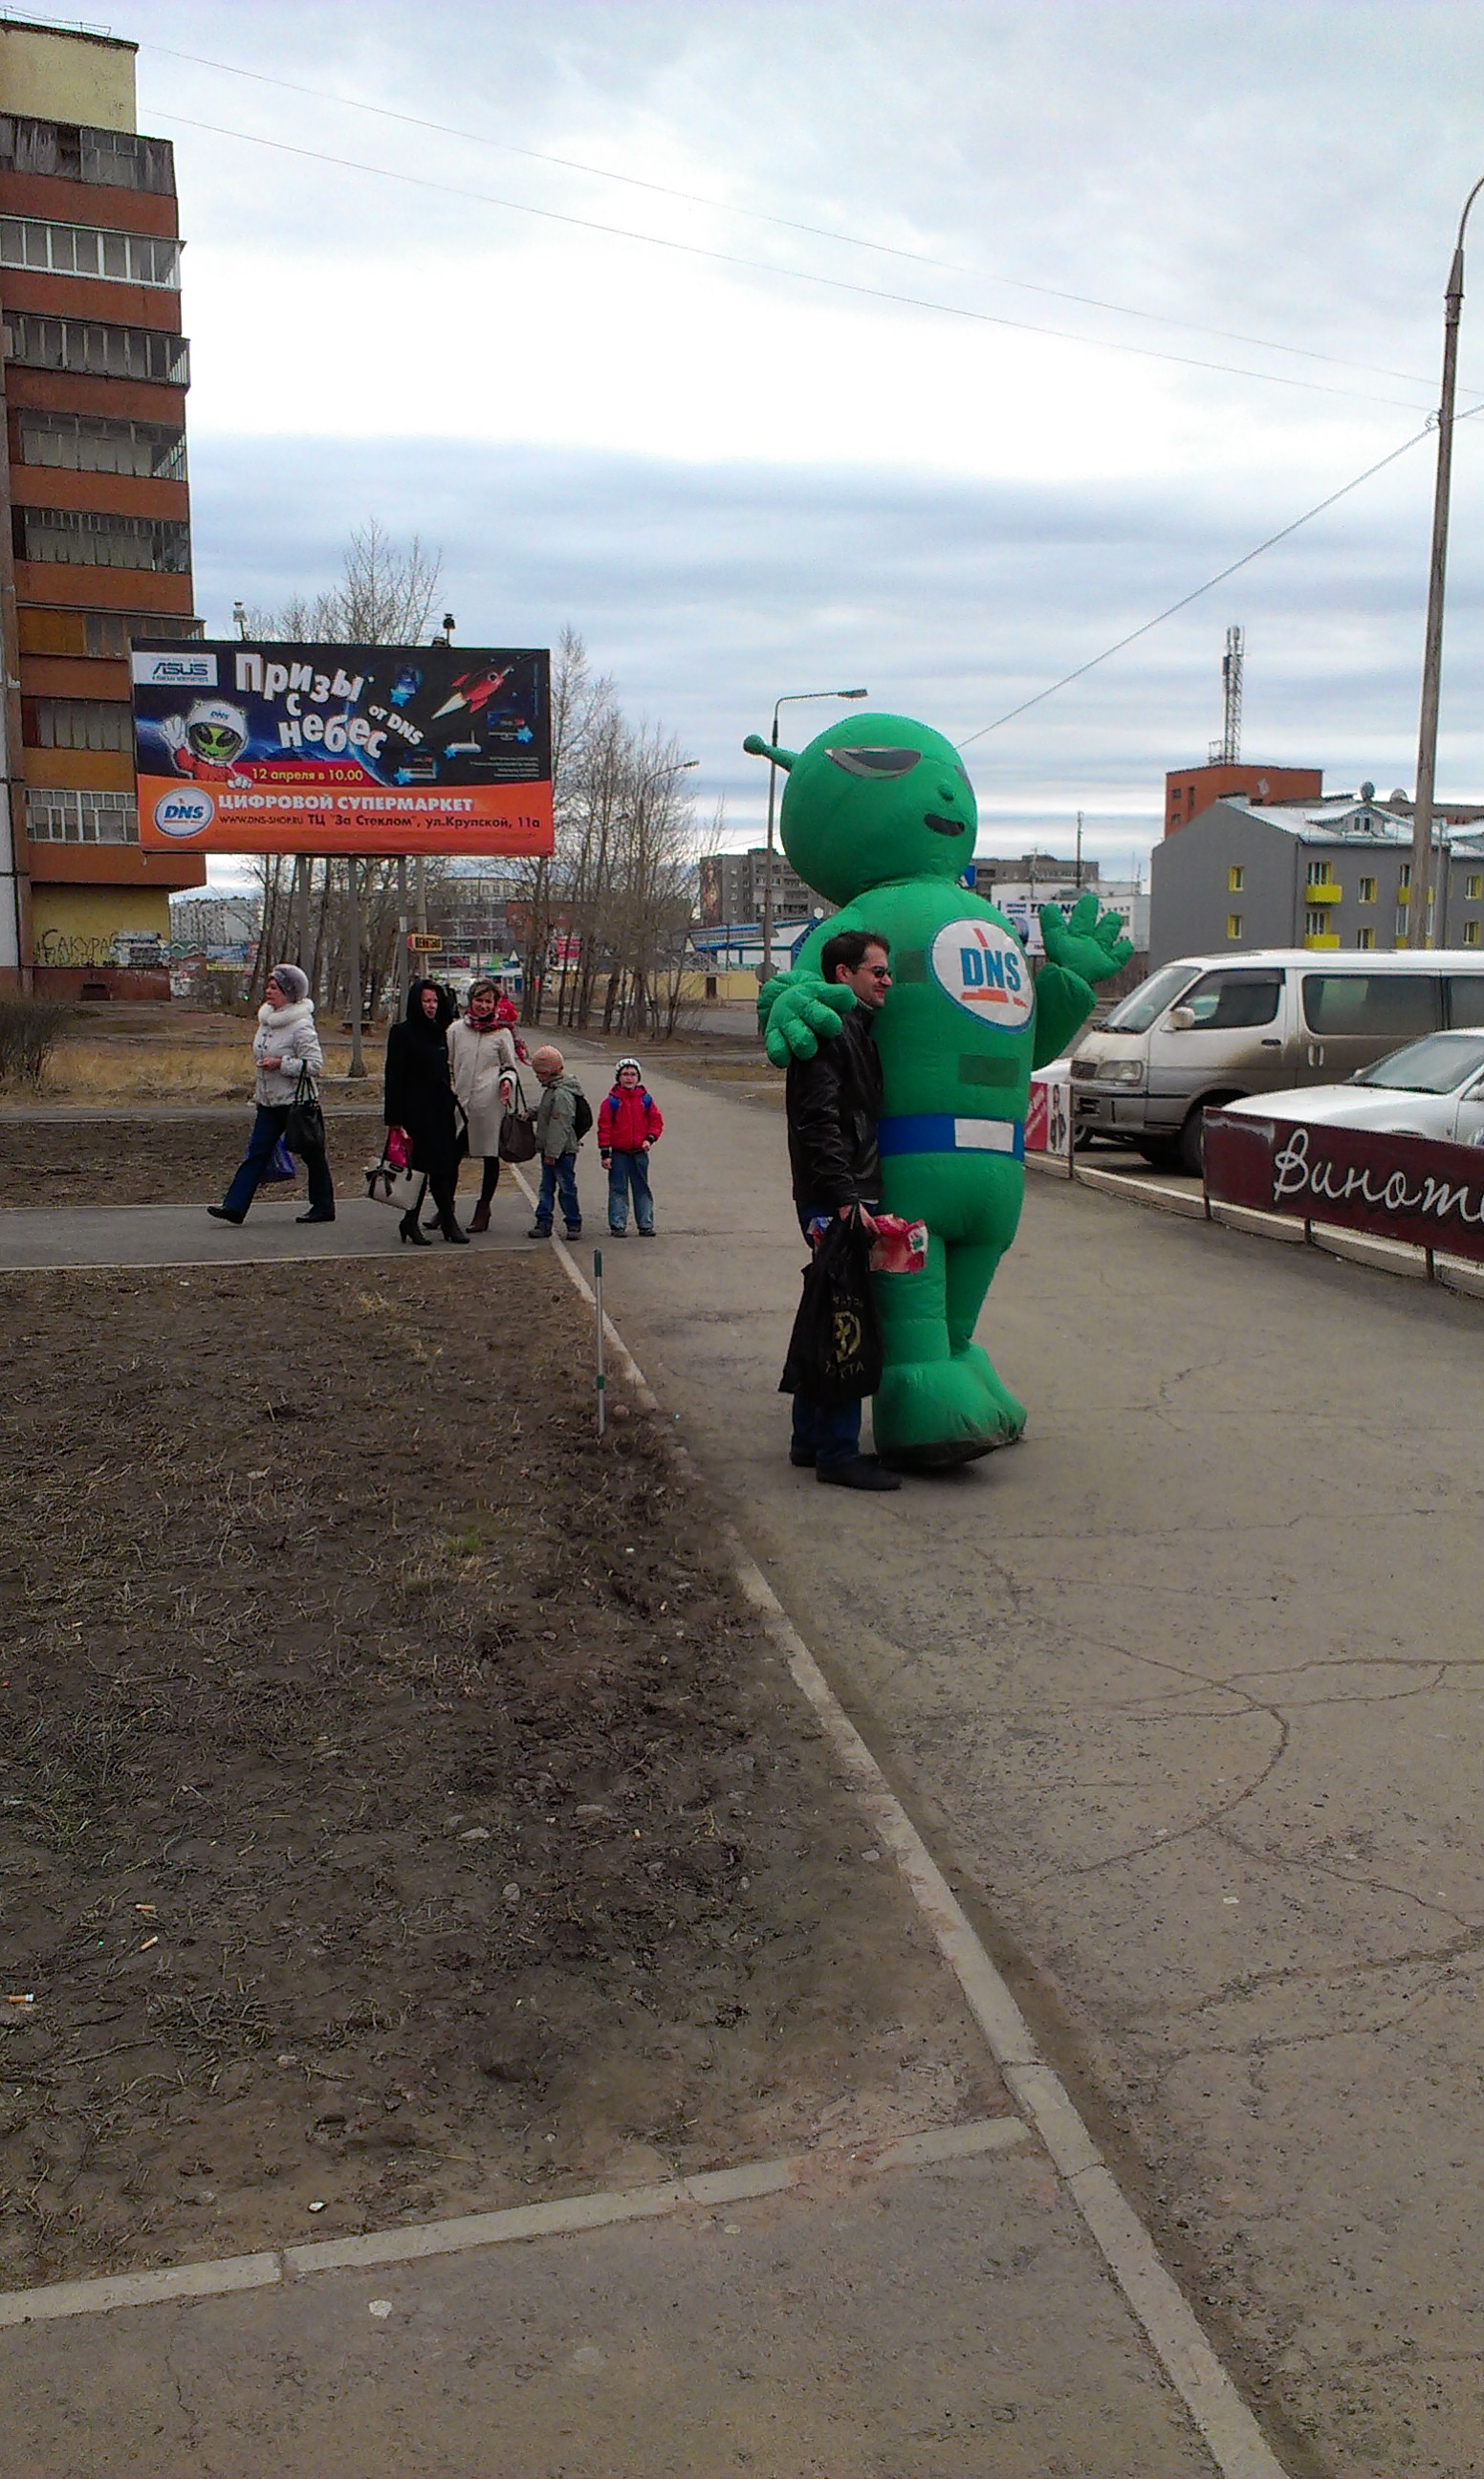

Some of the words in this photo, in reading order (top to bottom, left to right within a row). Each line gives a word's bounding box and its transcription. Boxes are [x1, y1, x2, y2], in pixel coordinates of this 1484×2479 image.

[152, 662, 208, 676] ASUS
[235, 652, 365, 704] Призы
[286, 691, 302, 717] с
[278, 713, 389, 759] небес
[368, 704, 388, 721] от
[386, 713, 426, 746] DNS
[251, 768, 267, 779] 12
[270, 771, 315, 782] апреля
[329, 769, 363, 781] 10.00
[164, 805, 205, 820] DNS
[218, 794, 334, 811] ЦИФРОВОЙ
[337, 796, 474, 812] СУПЕРМАРКЕТ
[307, 815, 326, 827] ТЦ
[960, 948, 1021, 992] DNS
[1274, 1128, 1484, 1223] Винот
